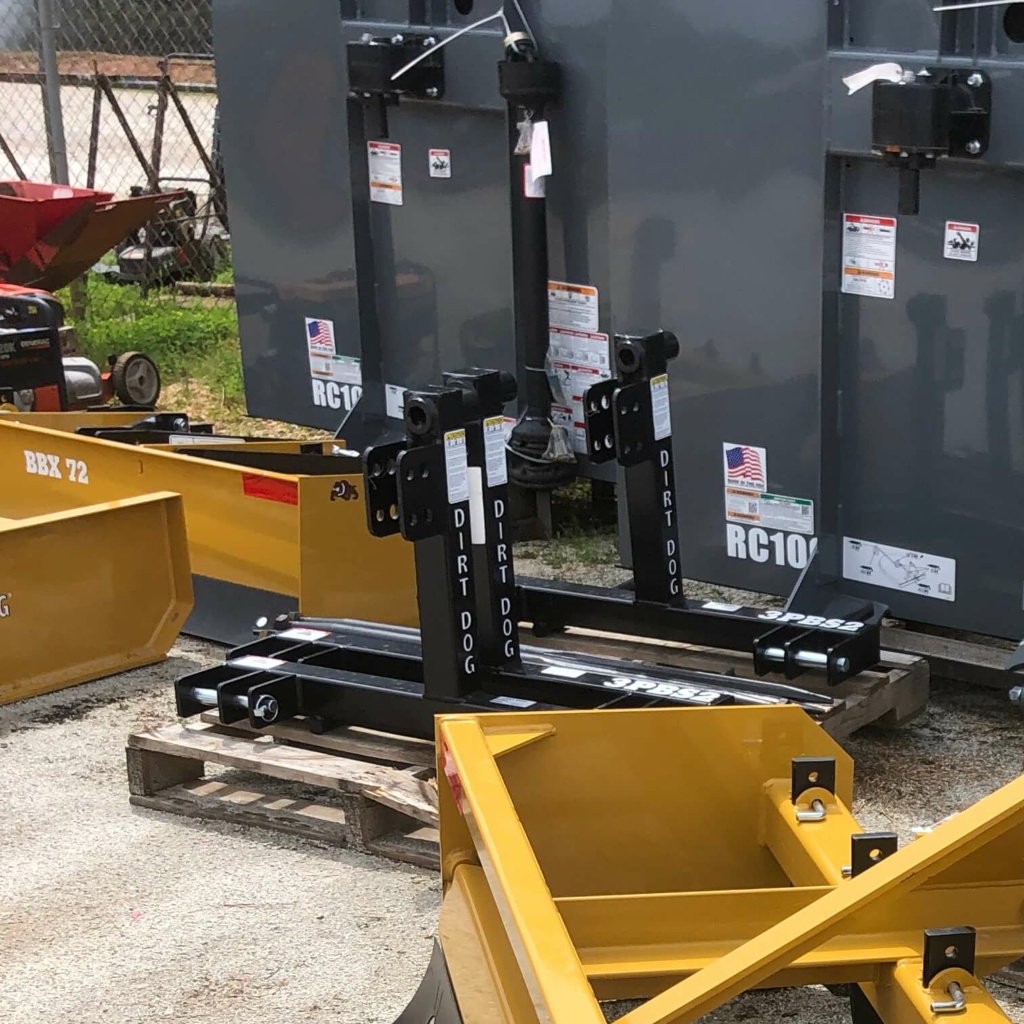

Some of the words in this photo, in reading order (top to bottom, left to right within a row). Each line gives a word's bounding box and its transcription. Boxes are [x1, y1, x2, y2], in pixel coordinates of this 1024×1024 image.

[24, 450, 62, 479] BBX
[65, 458, 89, 484] 72
[454, 508, 469, 596] DIRT
[659, 450, 674, 527] DIRT
[667, 540, 679, 595] DOG
[494, 500, 508, 584] DIRT
[501, 597, 514, 658] DOG
[461, 611, 475, 674] DOG
[757, 610, 865, 632] 3PBS2
[603, 677, 721, 702] 3PBS2
